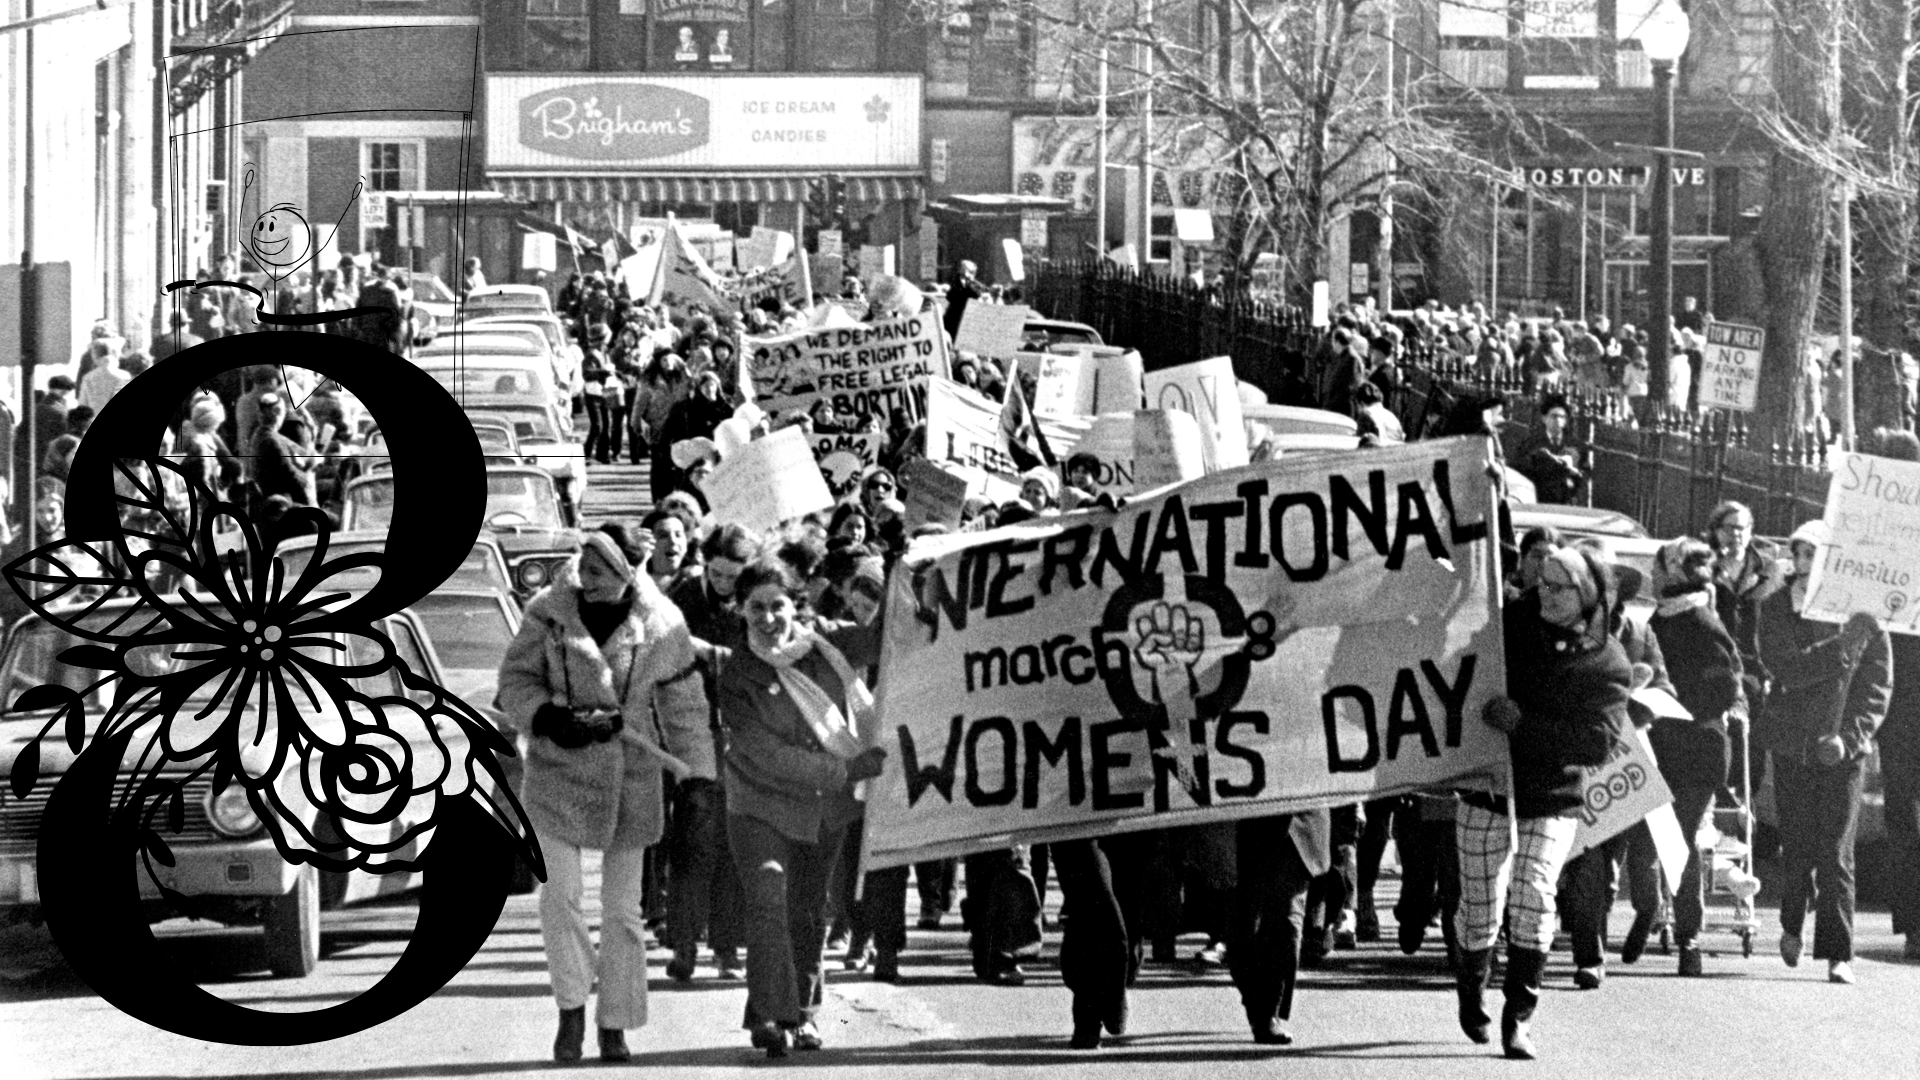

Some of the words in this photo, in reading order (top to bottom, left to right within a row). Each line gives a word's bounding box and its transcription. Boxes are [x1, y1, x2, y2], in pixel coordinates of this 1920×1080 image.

[531, 96, 693, 146] Brigham's
[742, 100, 770, 114] ICE
[751, 129, 827, 143] CANDIES
[806, 332, 830, 349] WE
[838, 319, 921, 347] DEMAND
[814, 351, 852, 370] THE
[857, 344, 907, 367] RIGHT
[912, 339, 932, 357] TO
[1719, 348, 1745, 366] NO
[818, 370, 869, 391] FREE
[880, 360, 934, 385] LEGAL
[1706, 361, 1755, 380] PARKING
[1715, 377, 1743, 390] ANY
[1714, 388, 1742, 405] TIME
[911, 459, 1487, 644] INTERNATIONAL
[964, 625, 1131, 693] march
[1246, 610, 1276, 662] 8
[1322, 654, 1477, 773] DAY
